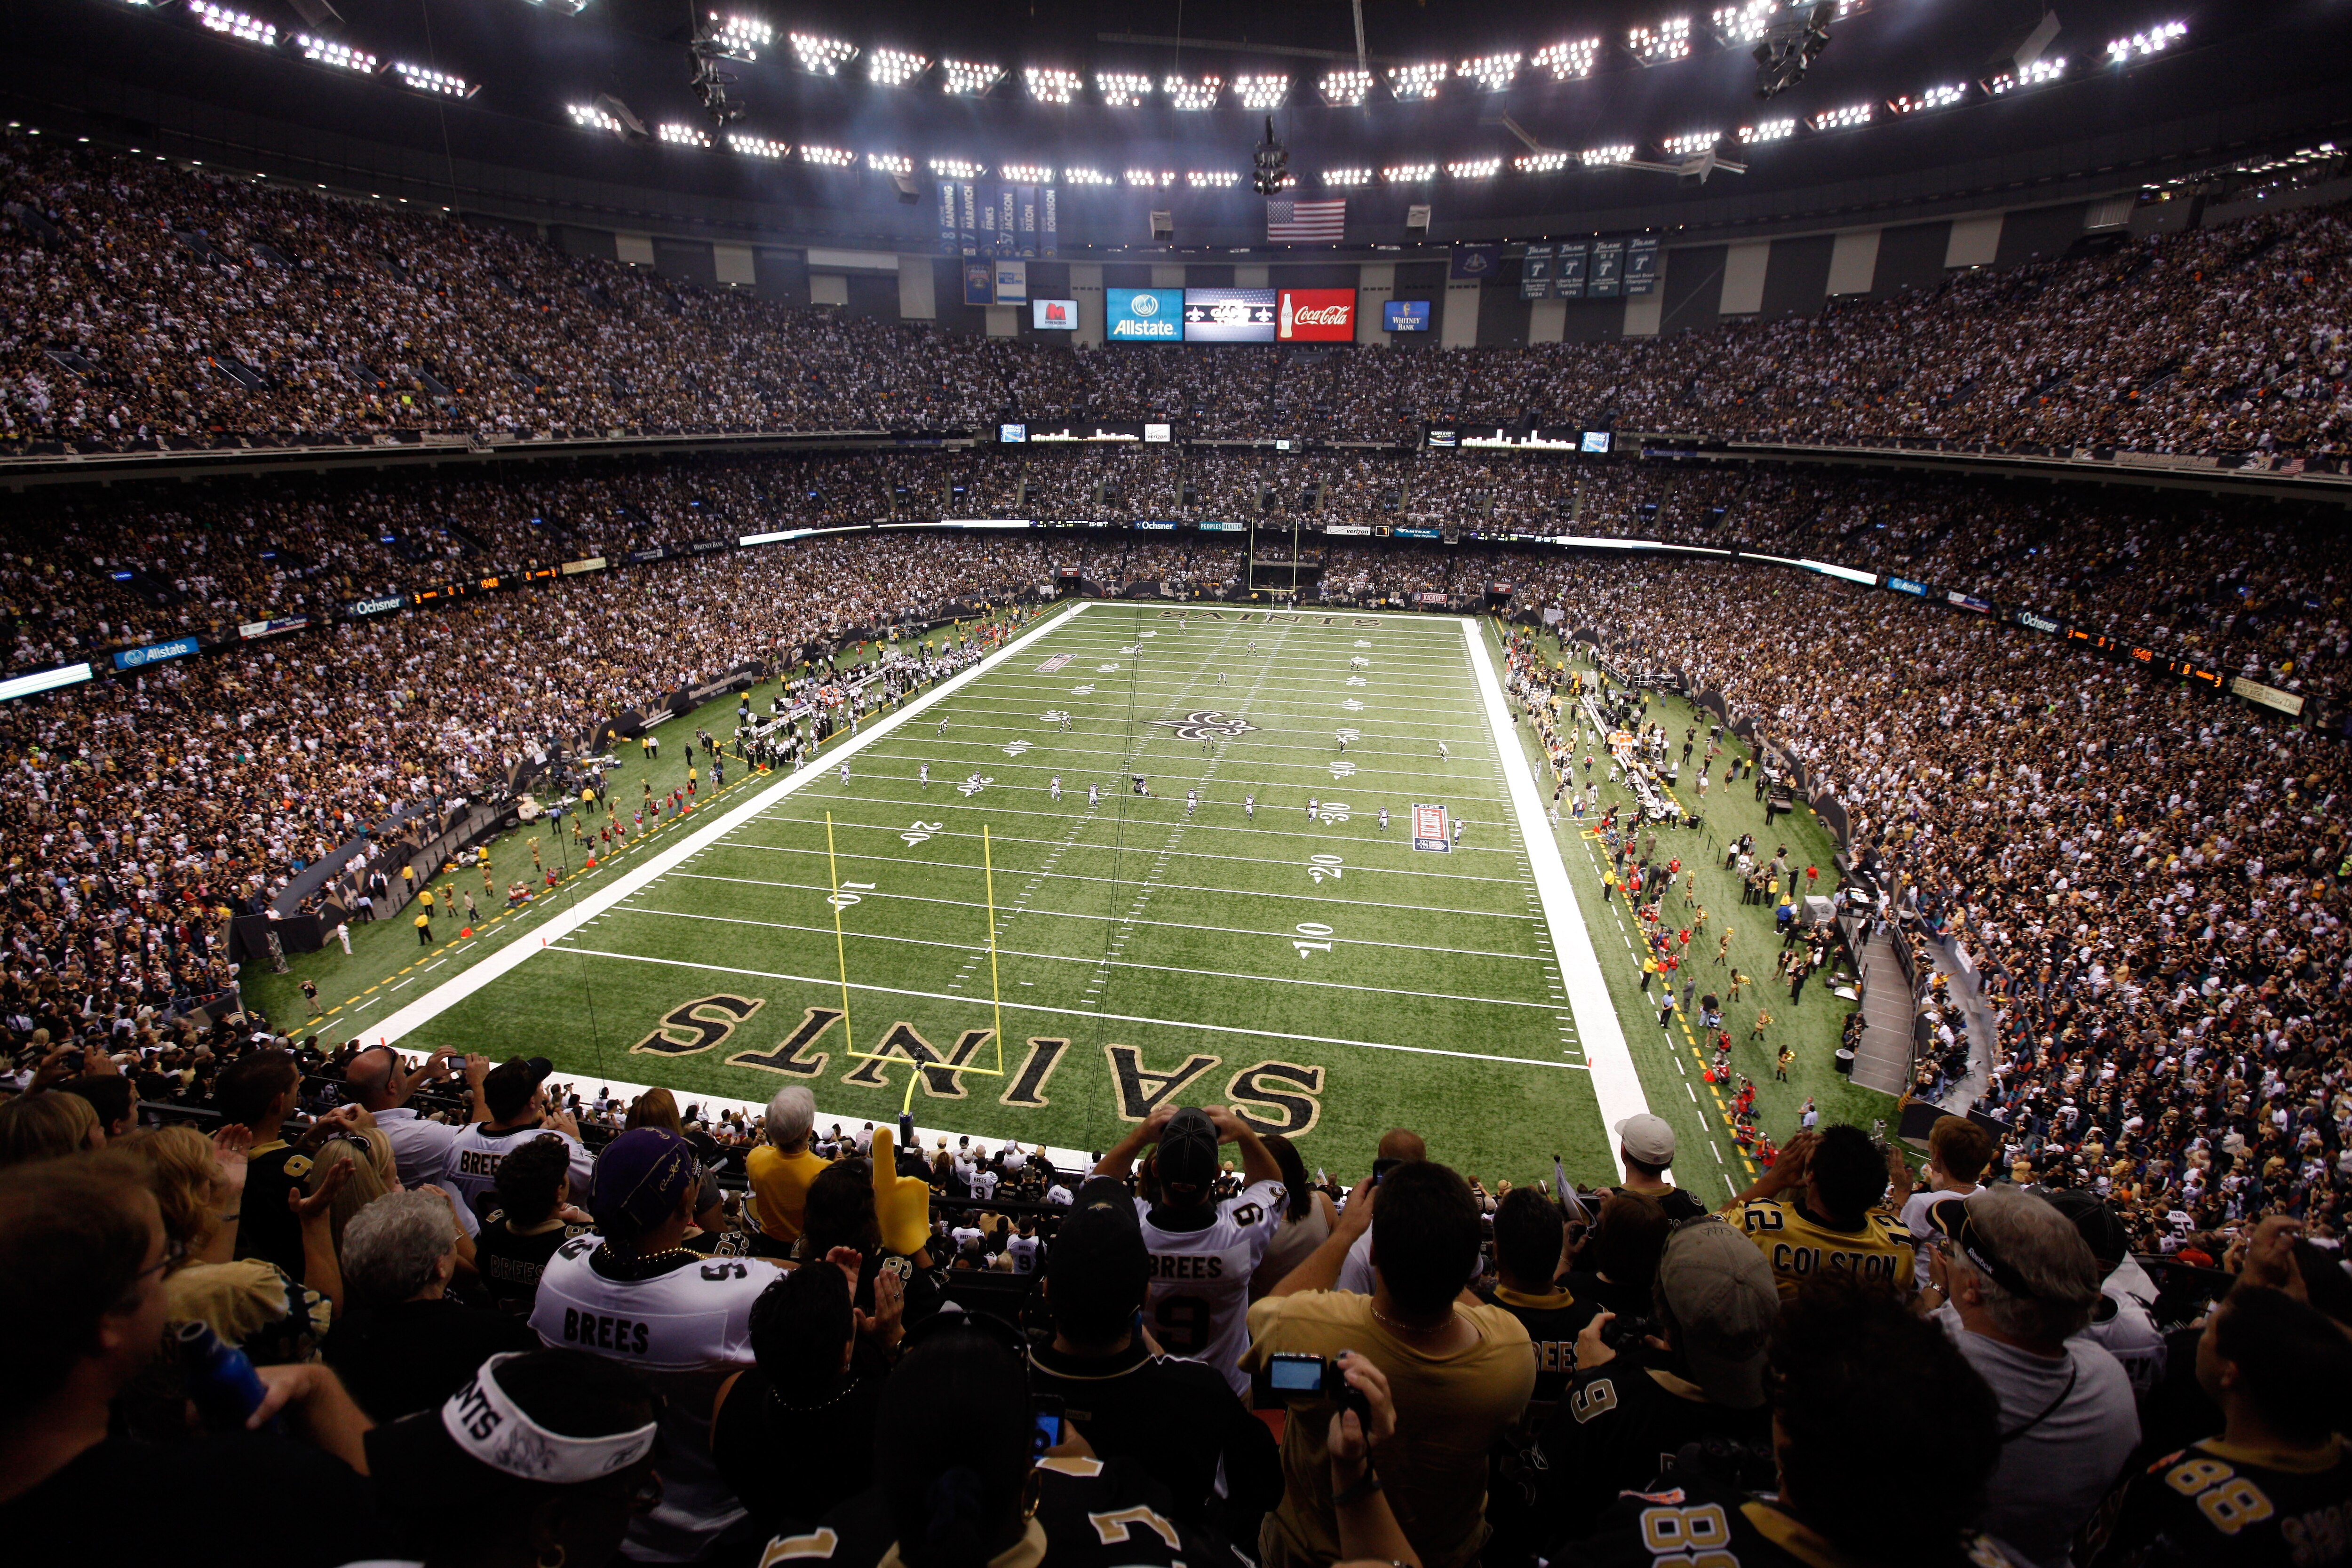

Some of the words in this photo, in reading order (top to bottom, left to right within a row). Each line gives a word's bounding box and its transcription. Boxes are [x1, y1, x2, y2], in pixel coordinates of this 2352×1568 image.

[943, 185, 955, 228] MANNING
[964, 185, 975, 229] MARAVICH
[1003, 193, 1013, 231] JACKSON
[1046, 190, 1056, 232] ROBINSON
[985, 206, 994, 230] FINKS
[1025, 205, 1034, 231] DIXON
[1000, 232, 1014, 245] 57
[1210, 308, 1251, 318] GAME
[1214, 317, 1248, 326] TIME
[1295, 305, 1351, 325] Coca-Cola
[1113, 320, 1173, 335] Allstate
[1142, 521, 1173, 530] Ochsner
[481, 578, 498, 589] 15:00
[525, 572, 531, 580] 0
[448, 587, 454, 595] 0
[1900, 582, 1922, 593] Allstate
[357, 597, 400, 615] Ochsner
[414, 595, 421, 604] 3
[1158, 611, 1383, 627] SAINTS
[2023, 612, 2058, 632] Ochsner
[1355, 639, 1371, 648] 10
[2098, 637, 2105, 646] 0
[146, 643, 188, 661] Allstate
[2132, 648, 2152, 661] 15:00
[1096, 664, 1120, 673] 30
[2183, 664, 2190, 674] 0
[1071, 685, 1095, 695] 40
[1346, 676, 1367, 687] 30
[2214, 677, 2222, 687] 3
[1342, 700, 1364, 711] 40
[1039, 710, 1069, 721] 50
[1336, 728, 1360, 741] 50
[1002, 740, 1033, 753] 40
[1328, 761, 1356, 777] 40
[1319, 802, 1351, 822] 30
[900, 820, 943, 842] 20
[1420, 809, 1442, 838] KICKOFF
[1308, 854, 1343, 879] 20
[827, 880, 876, 905] 10
[1292, 923, 1334, 952] 10
[629, 994, 1326, 1138] SAINTS
[976, 1187, 985, 1199] 9
[1233, 1202, 1263, 1226] 9
[1744, 1197, 1784, 1231] 12
[1873, 1214, 1914, 1250] 12
[1019, 1255, 1031, 1271] 9
[1148, 1255, 1222, 1279] BREES
[1773, 1243, 1898, 1281] COLSTON
[1968, 1247, 1994, 1274] Reebok
[491, 1255, 546, 1285] BREES
[564, 1307, 649, 1354] BREES
[1157, 1296, 1209, 1353] 9
[1571, 1378, 1618, 1425] 9
[2164, 1457, 2275, 1535] 88
